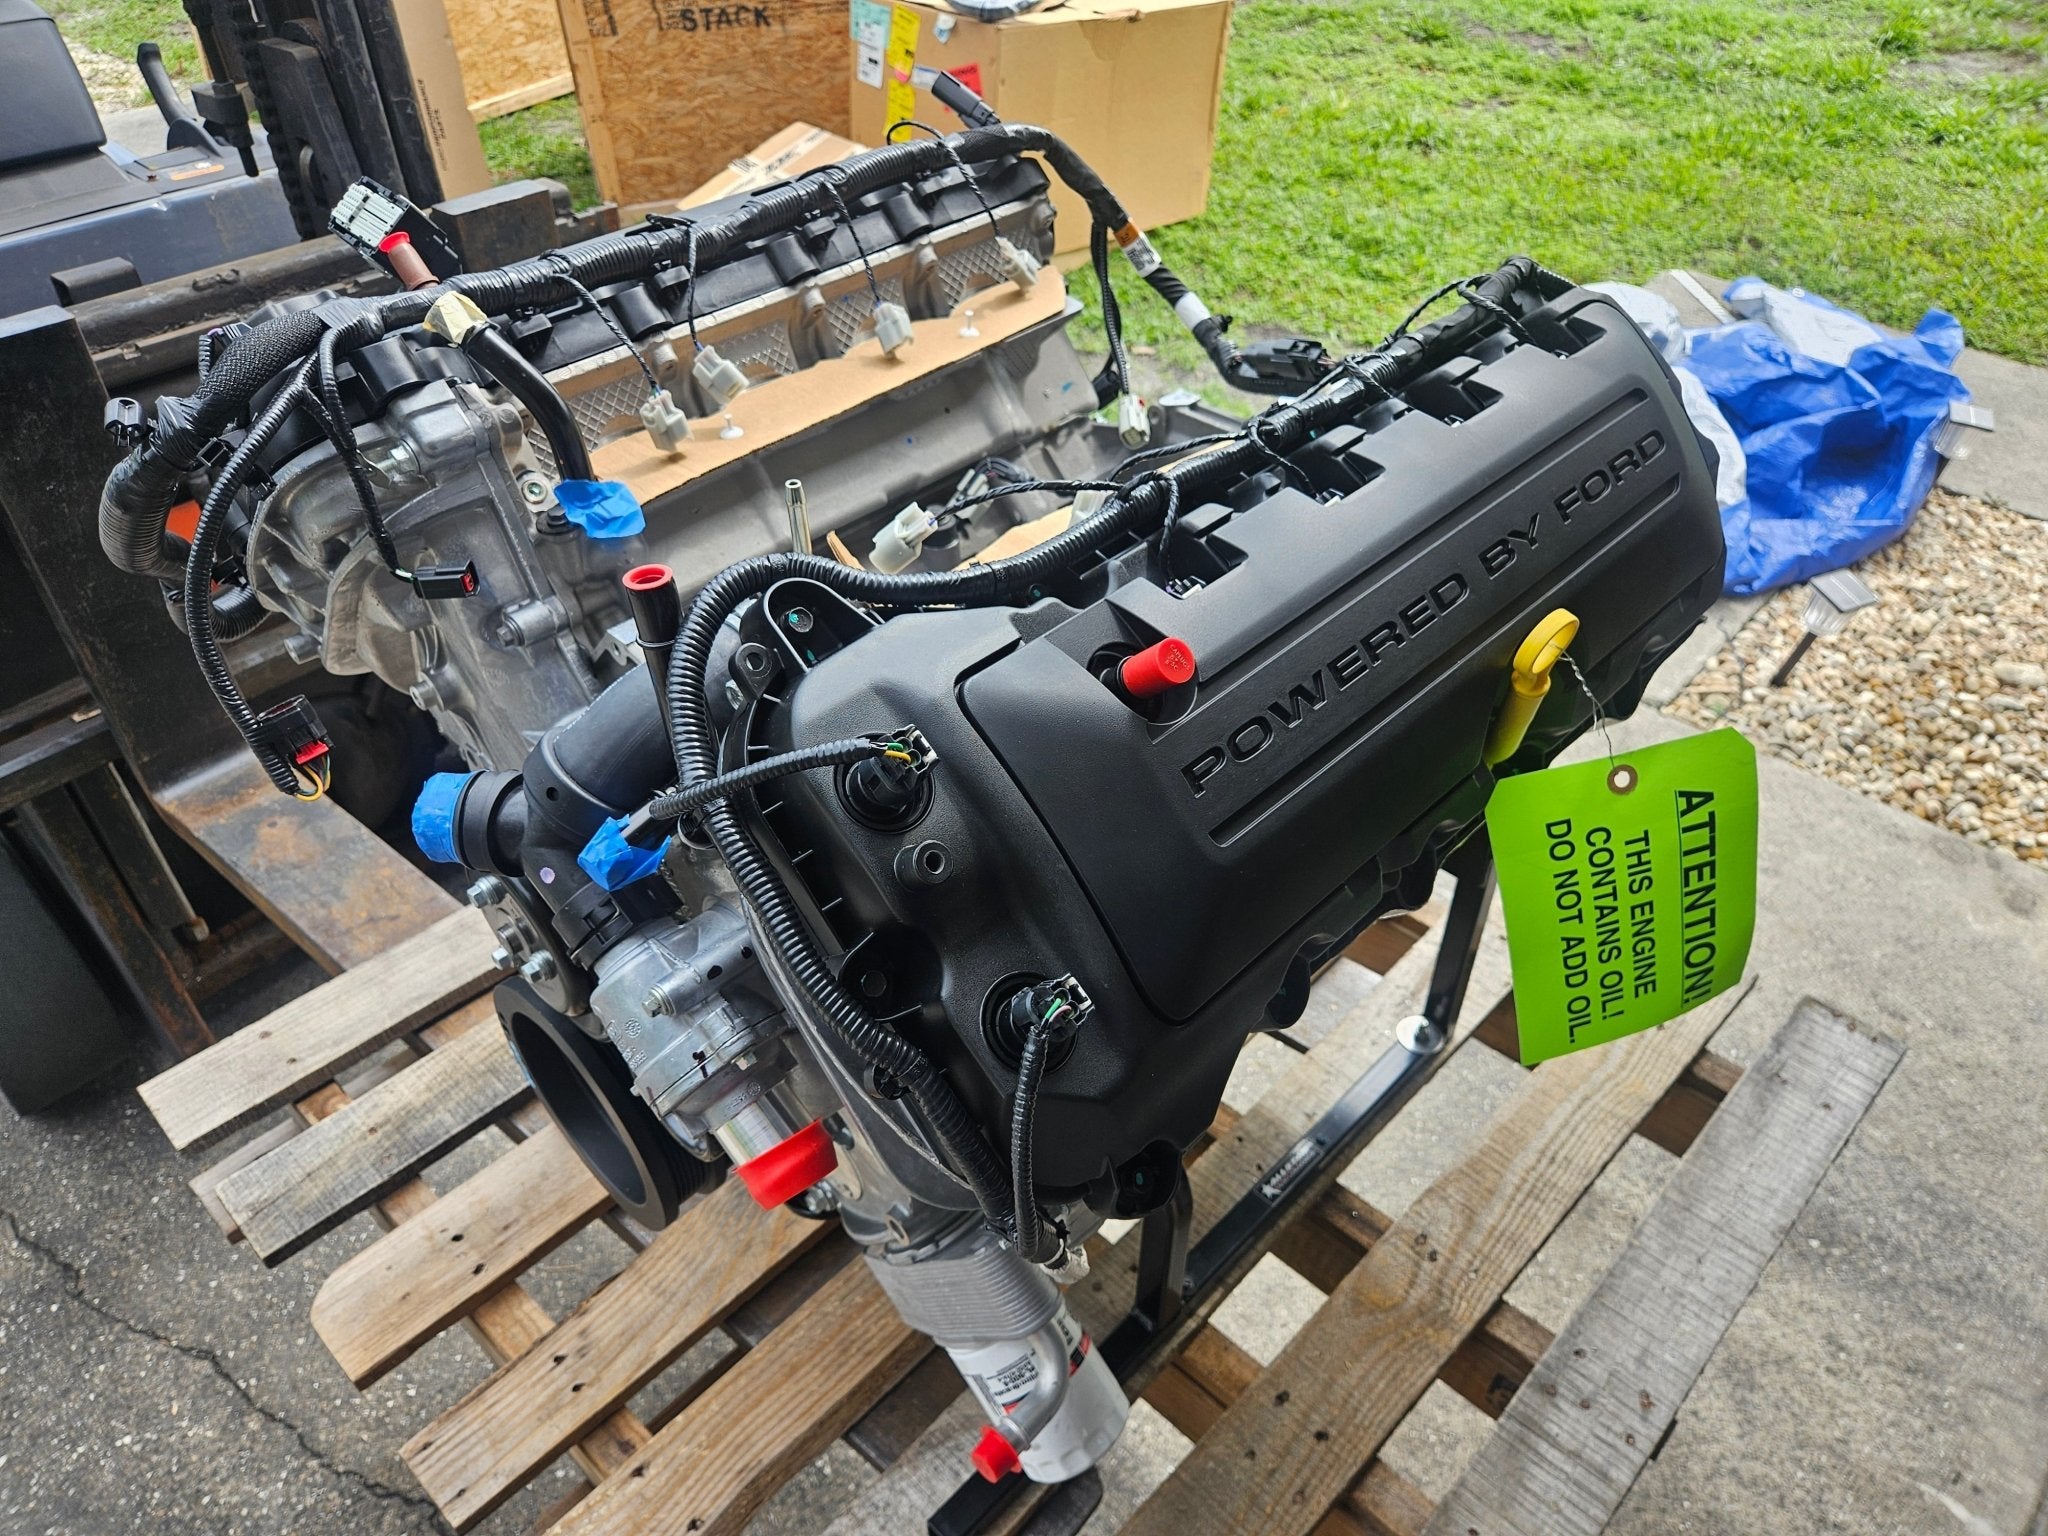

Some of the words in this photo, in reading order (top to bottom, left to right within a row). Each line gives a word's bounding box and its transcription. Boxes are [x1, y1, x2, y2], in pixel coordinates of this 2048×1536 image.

[680, 7, 771, 32] STACK
[1181, 573, 1470, 798] POWERED
[1478, 512, 1540, 580] BY
[1553, 429, 1667, 525] FORD
[1545, 818, 1576, 862] DO
[1624, 829, 1654, 895] THIS
[1552, 868, 1584, 924] NOT
[1585, 826, 1622, 964] CONTAINS
[1677, 789, 1717, 1004] ATTENTION!
[1559, 936, 1589, 989] ADD
[1629, 900, 1657, 999] ENGINE
[1566, 995, 1592, 1044] OIL.
[1599, 970, 1625, 1021] OIL!
